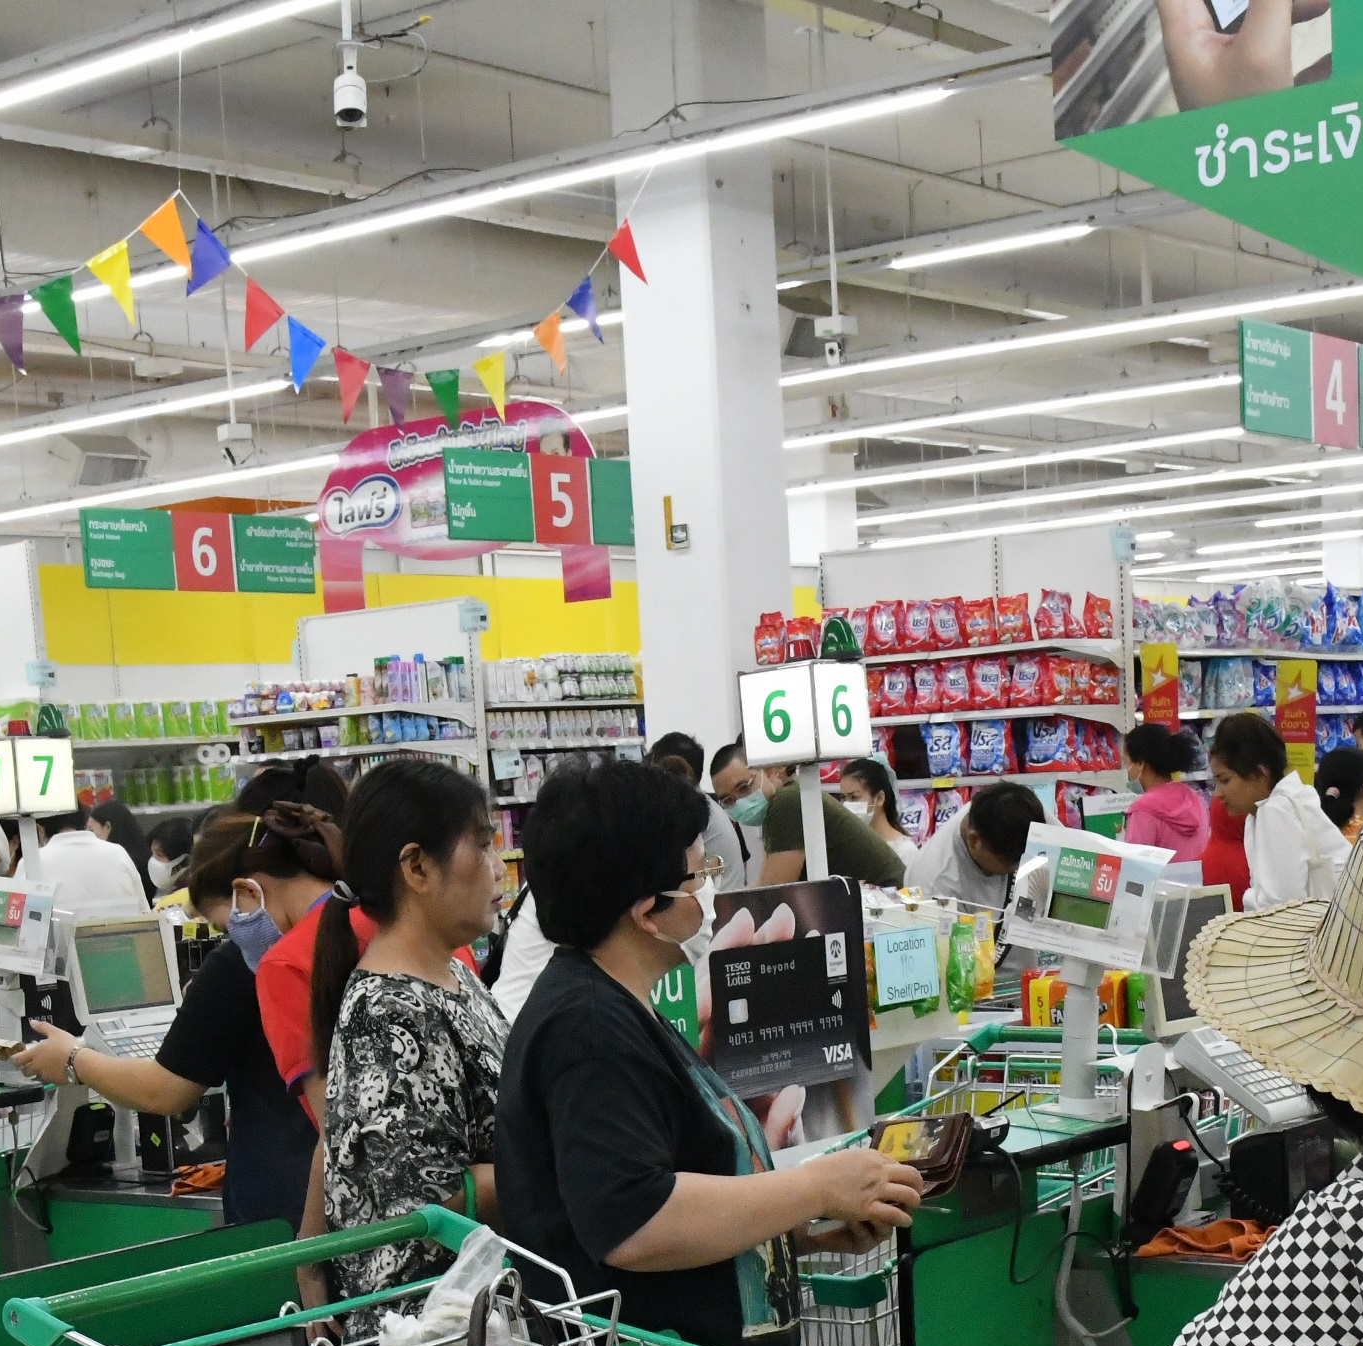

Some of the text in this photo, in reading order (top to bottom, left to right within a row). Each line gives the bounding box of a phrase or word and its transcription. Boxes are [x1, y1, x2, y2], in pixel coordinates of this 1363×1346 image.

[1325, 359, 1346, 425] 4
[550, 473, 574, 527] 5
[192, 527, 217, 577] 6
[762, 690, 792, 743] 6
[831, 685, 852, 737] 6
[33, 755, 54, 796] 7
[887, 937, 926, 953] Location
[725, 961, 751, 973] TESCO
[727, 975, 751, 987] Lotus
[760, 960, 795, 975] Beyond
[887, 982, 933, 1001] Shelf(Pro)
[729, 1015, 843, 1046] 4093 9999 9999 9999
[822, 1043, 853, 1063] VISA
